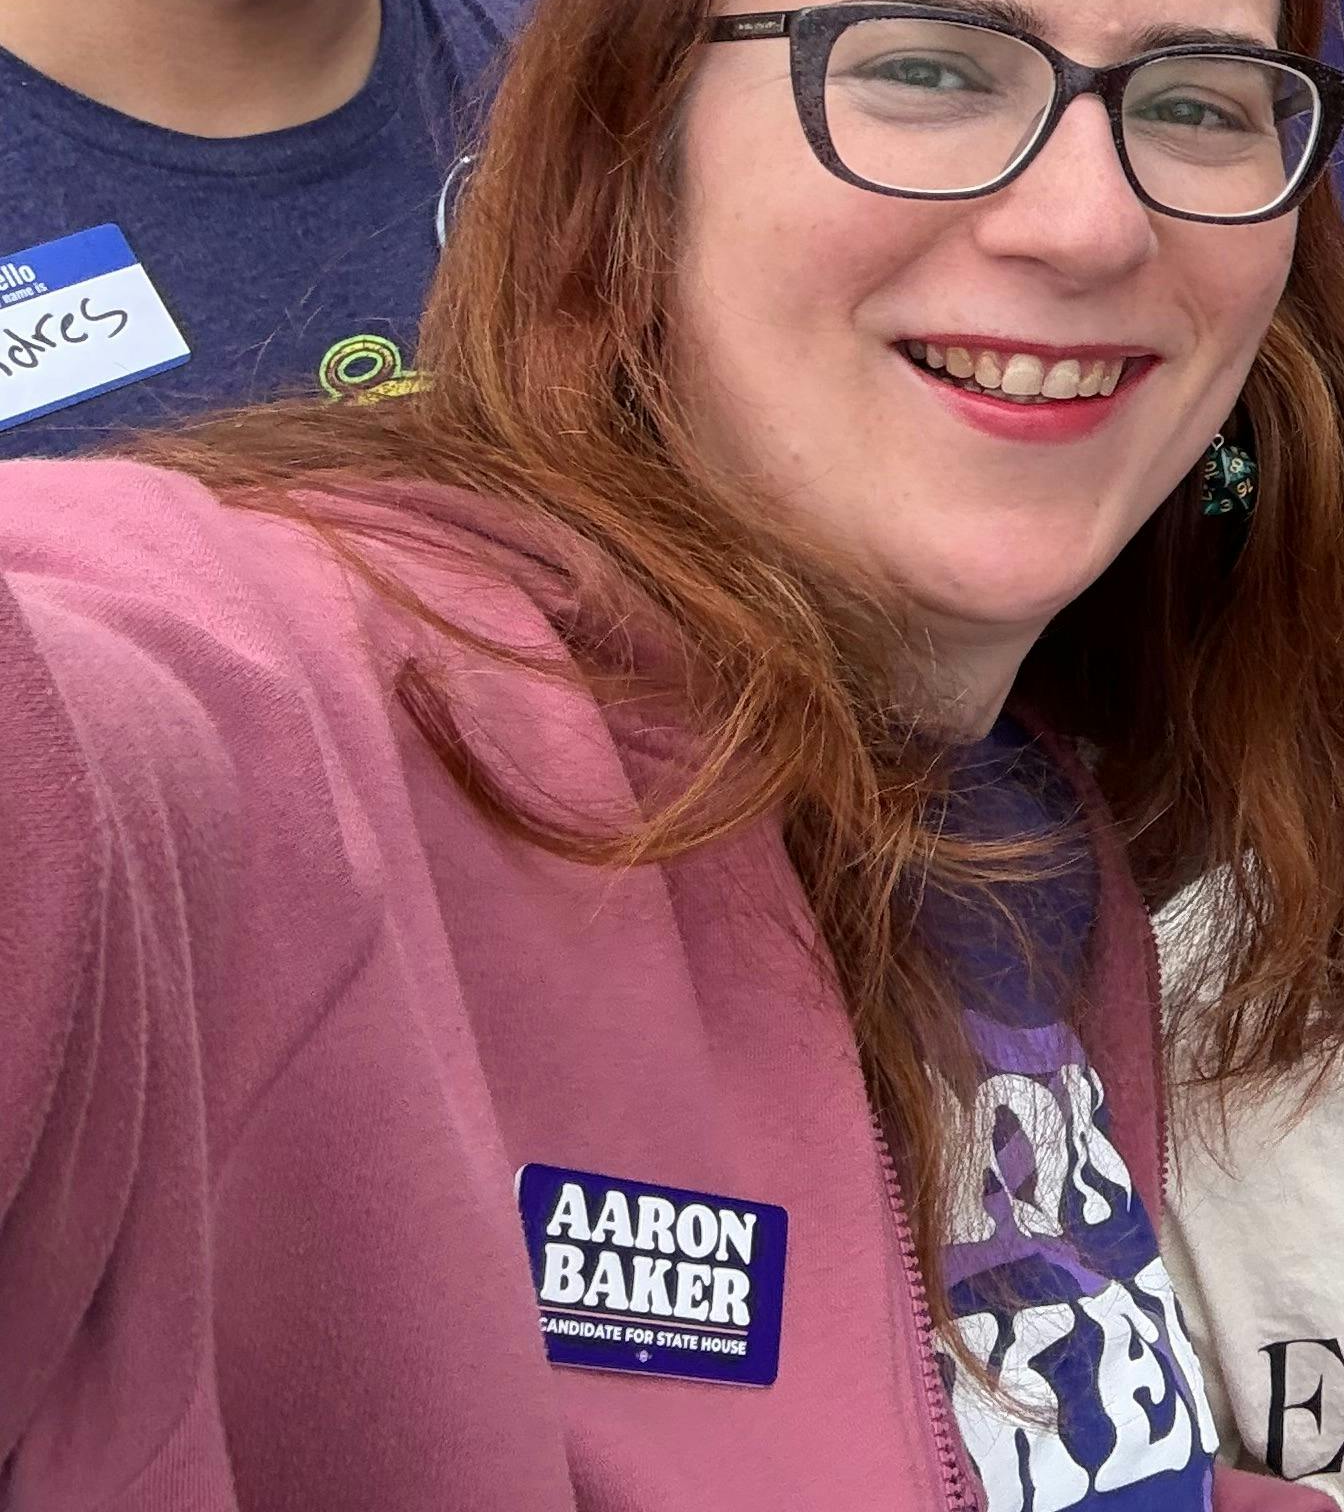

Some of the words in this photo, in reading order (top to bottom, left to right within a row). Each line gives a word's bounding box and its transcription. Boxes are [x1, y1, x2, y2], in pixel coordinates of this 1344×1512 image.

[0, 262, 36, 291] ello
[2, 285, 35, 304] name
[32, 281, 48, 294] is
[546, 1182, 758, 1266] AARON
[540, 1242, 751, 1326] BAKER
[538, 1316, 622, 1341] CANDIDATE
[625, 1327, 654, 1345] FOR
[656, 1330, 698, 1350] STATE
[700, 1335, 747, 1356] HOUSE
